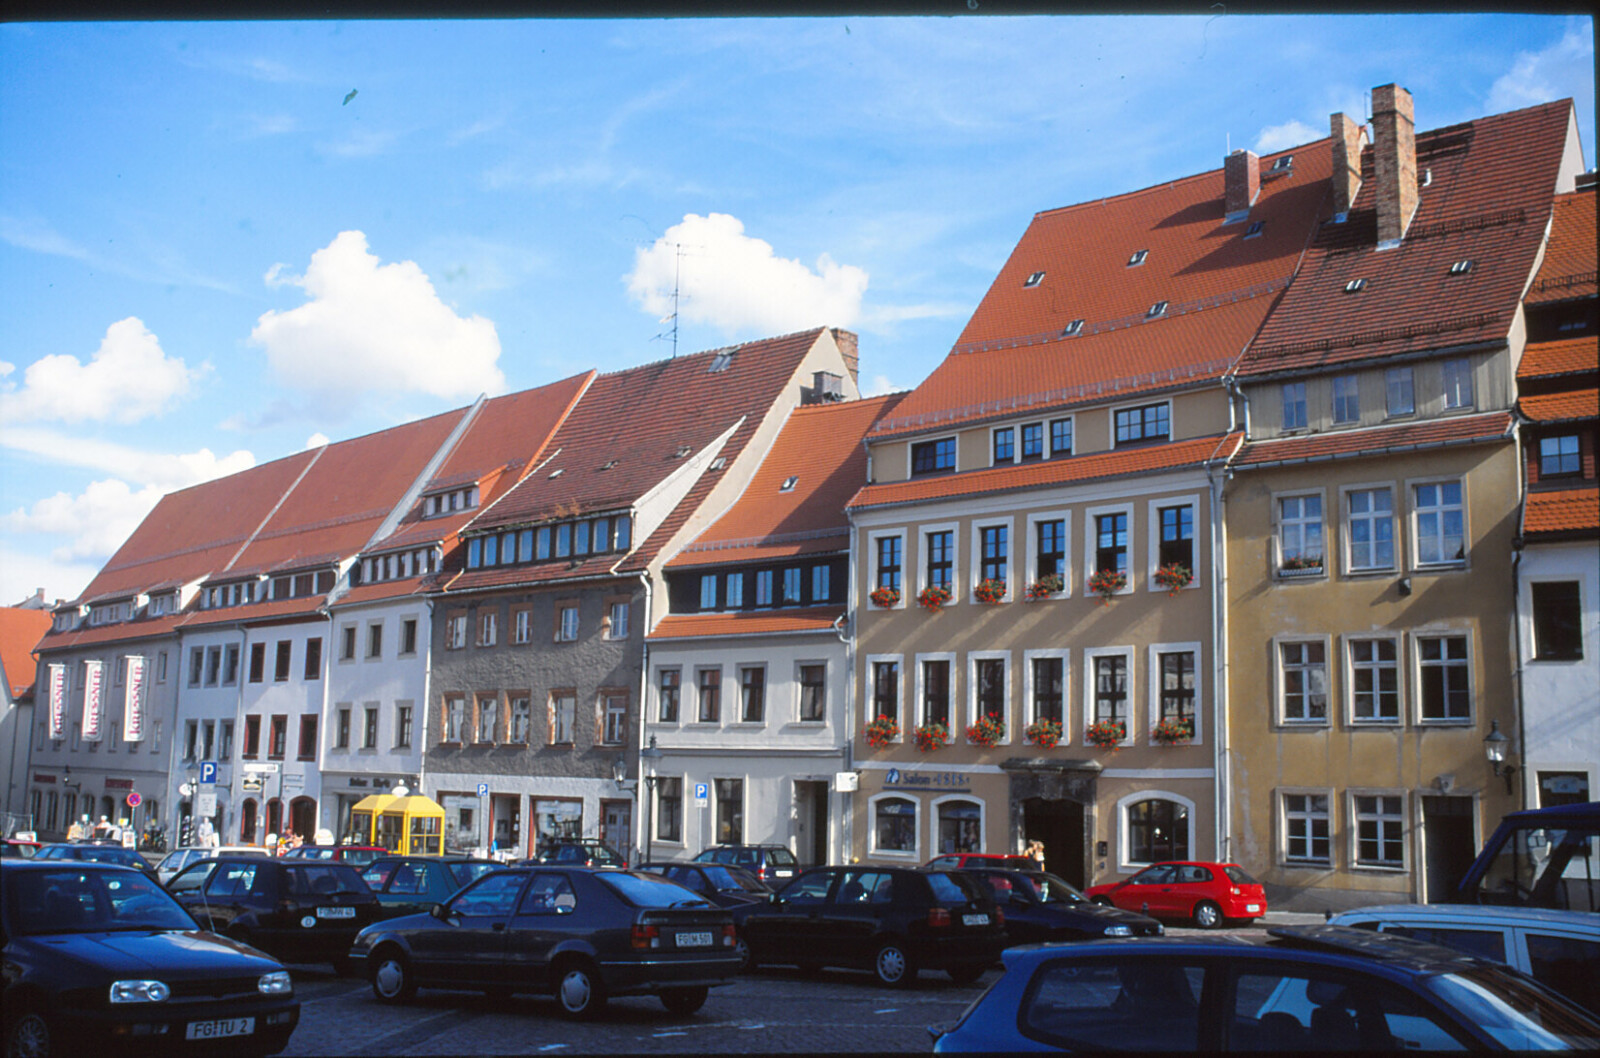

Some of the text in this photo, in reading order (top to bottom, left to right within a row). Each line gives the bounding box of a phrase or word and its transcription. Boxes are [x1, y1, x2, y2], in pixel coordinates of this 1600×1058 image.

[203, 764, 214, 782] P
[903, 773, 930, 784] Salon
[479, 784, 486, 795] P
[697, 785, 705, 797] P
[194, 1019, 248, 1037] FG TU 2
